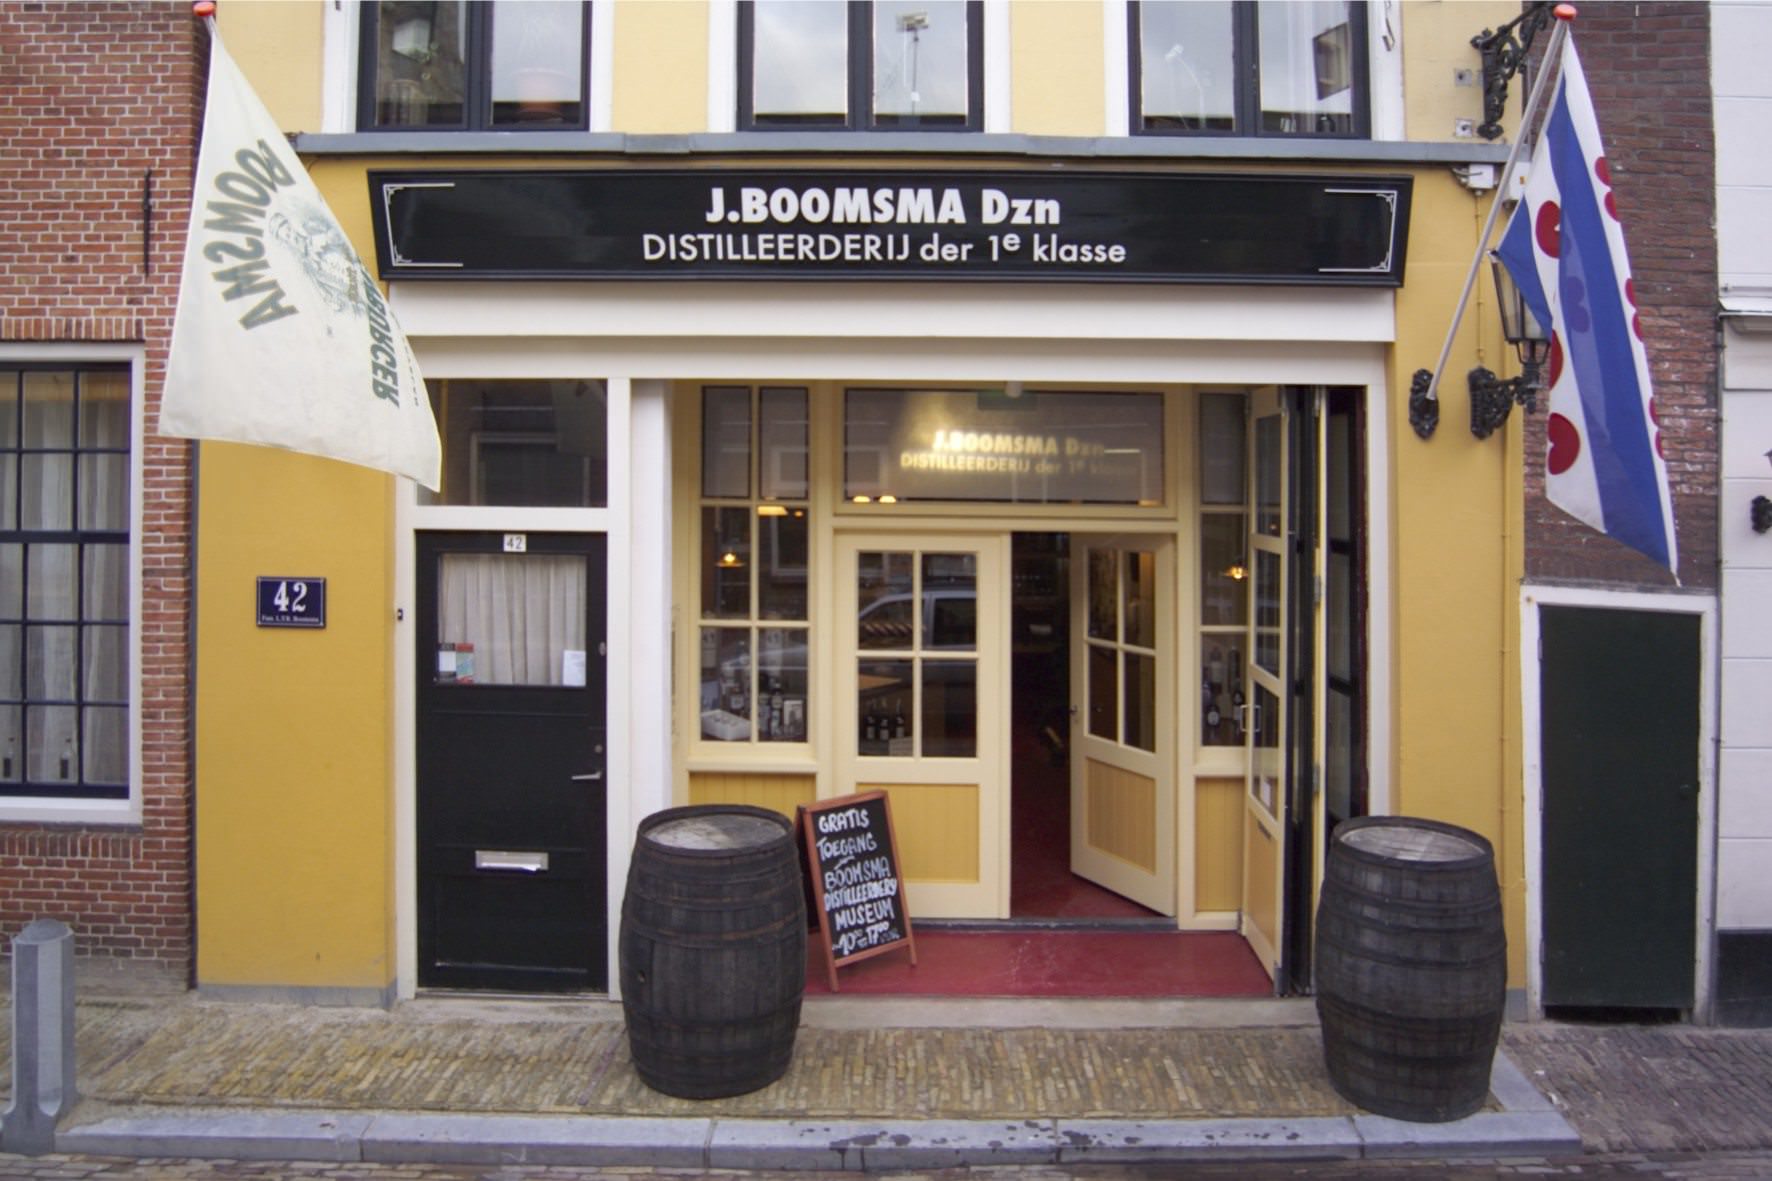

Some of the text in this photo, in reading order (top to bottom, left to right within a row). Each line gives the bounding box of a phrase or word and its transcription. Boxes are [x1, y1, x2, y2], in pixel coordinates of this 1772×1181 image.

[706, 187, 1061, 225] J.BOOMSMA Dzn
[642, 233, 910, 262] DISTILLEERDERIJ
[919, 233, 974, 262] der
[1032, 233, 1126, 263] klasse
[505, 535, 523, 549] 42
[273, 580, 308, 613] 42
[818, 808, 870, 834] GRATIS
[816, 832, 877, 861] TOEGANG
[824, 856, 891, 890] BOOMSMA
[835, 897, 895, 931] MUSEUM
